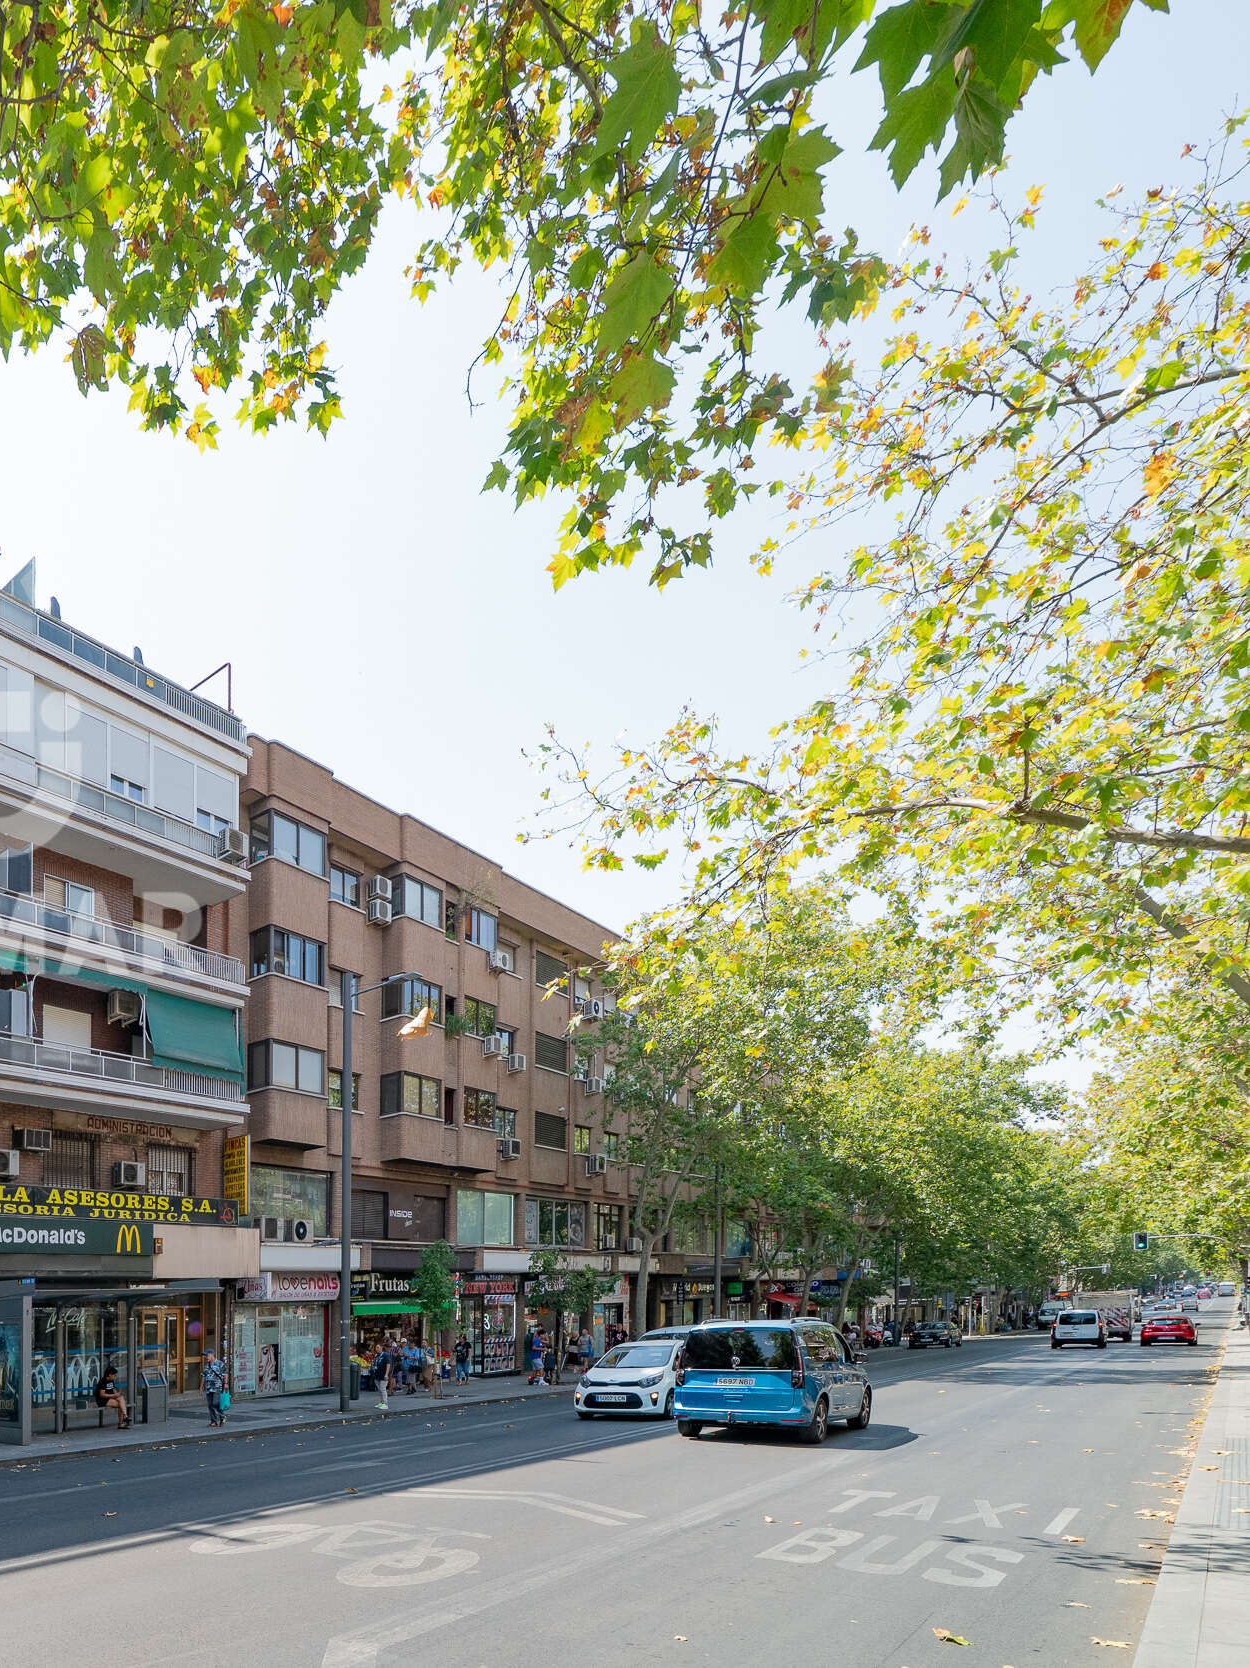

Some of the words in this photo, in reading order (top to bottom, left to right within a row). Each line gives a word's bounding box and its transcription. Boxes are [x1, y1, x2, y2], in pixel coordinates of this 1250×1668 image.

[87, 1117, 172, 1138] ADMINISTRACION
[89, 1208, 191, 1222] JURIDICA
[181, 1198, 218, 1214] S.A.
[277, 1273, 339, 1291] lovenails
[370, 1272, 410, 1292] Frutas
[489, 1281, 515, 1293] YORK
[827, 1489, 1081, 1535] TAXI
[752, 1527, 1025, 1588] BUS
